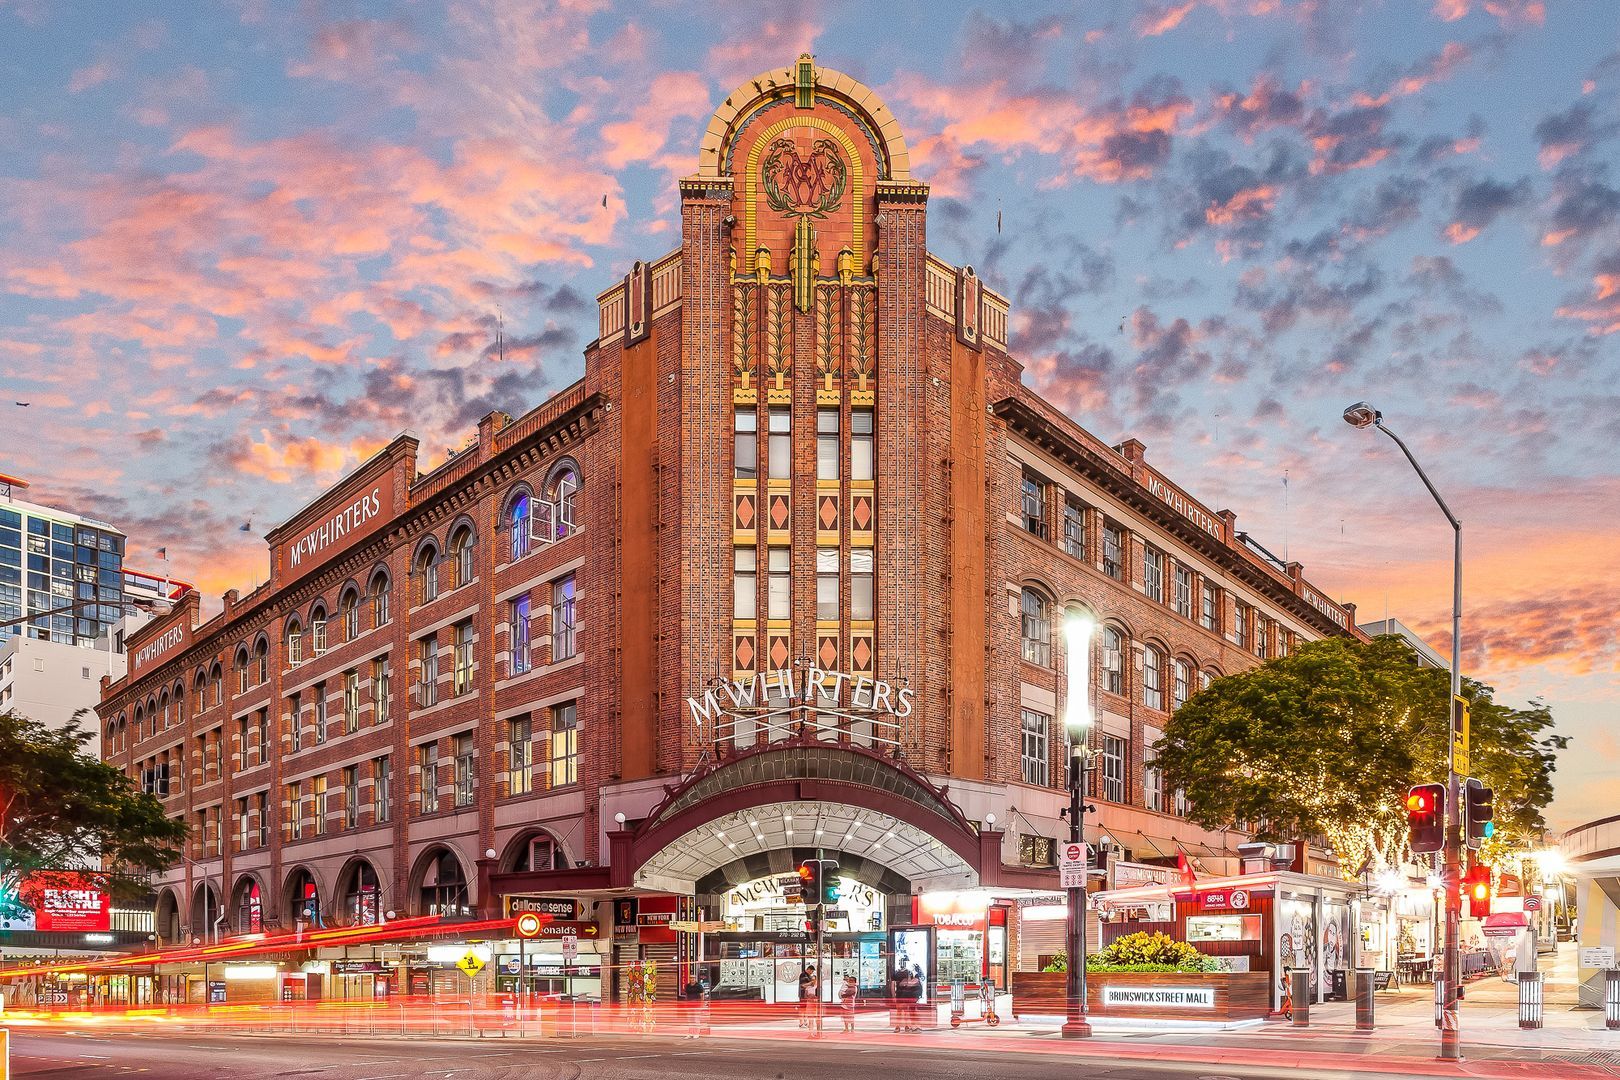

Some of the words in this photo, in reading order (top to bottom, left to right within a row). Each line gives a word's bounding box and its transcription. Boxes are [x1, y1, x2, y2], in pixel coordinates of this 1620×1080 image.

[1136, 868, 1182, 885] McWHIRERS
[548, 902, 573, 913] sense
[933, 913, 975, 926] TOBACCO
[1109, 991, 1154, 1002] BRUNSWICK
[1155, 992, 1184, 1003] STREET
[1186, 993, 1208, 1004] MALL
